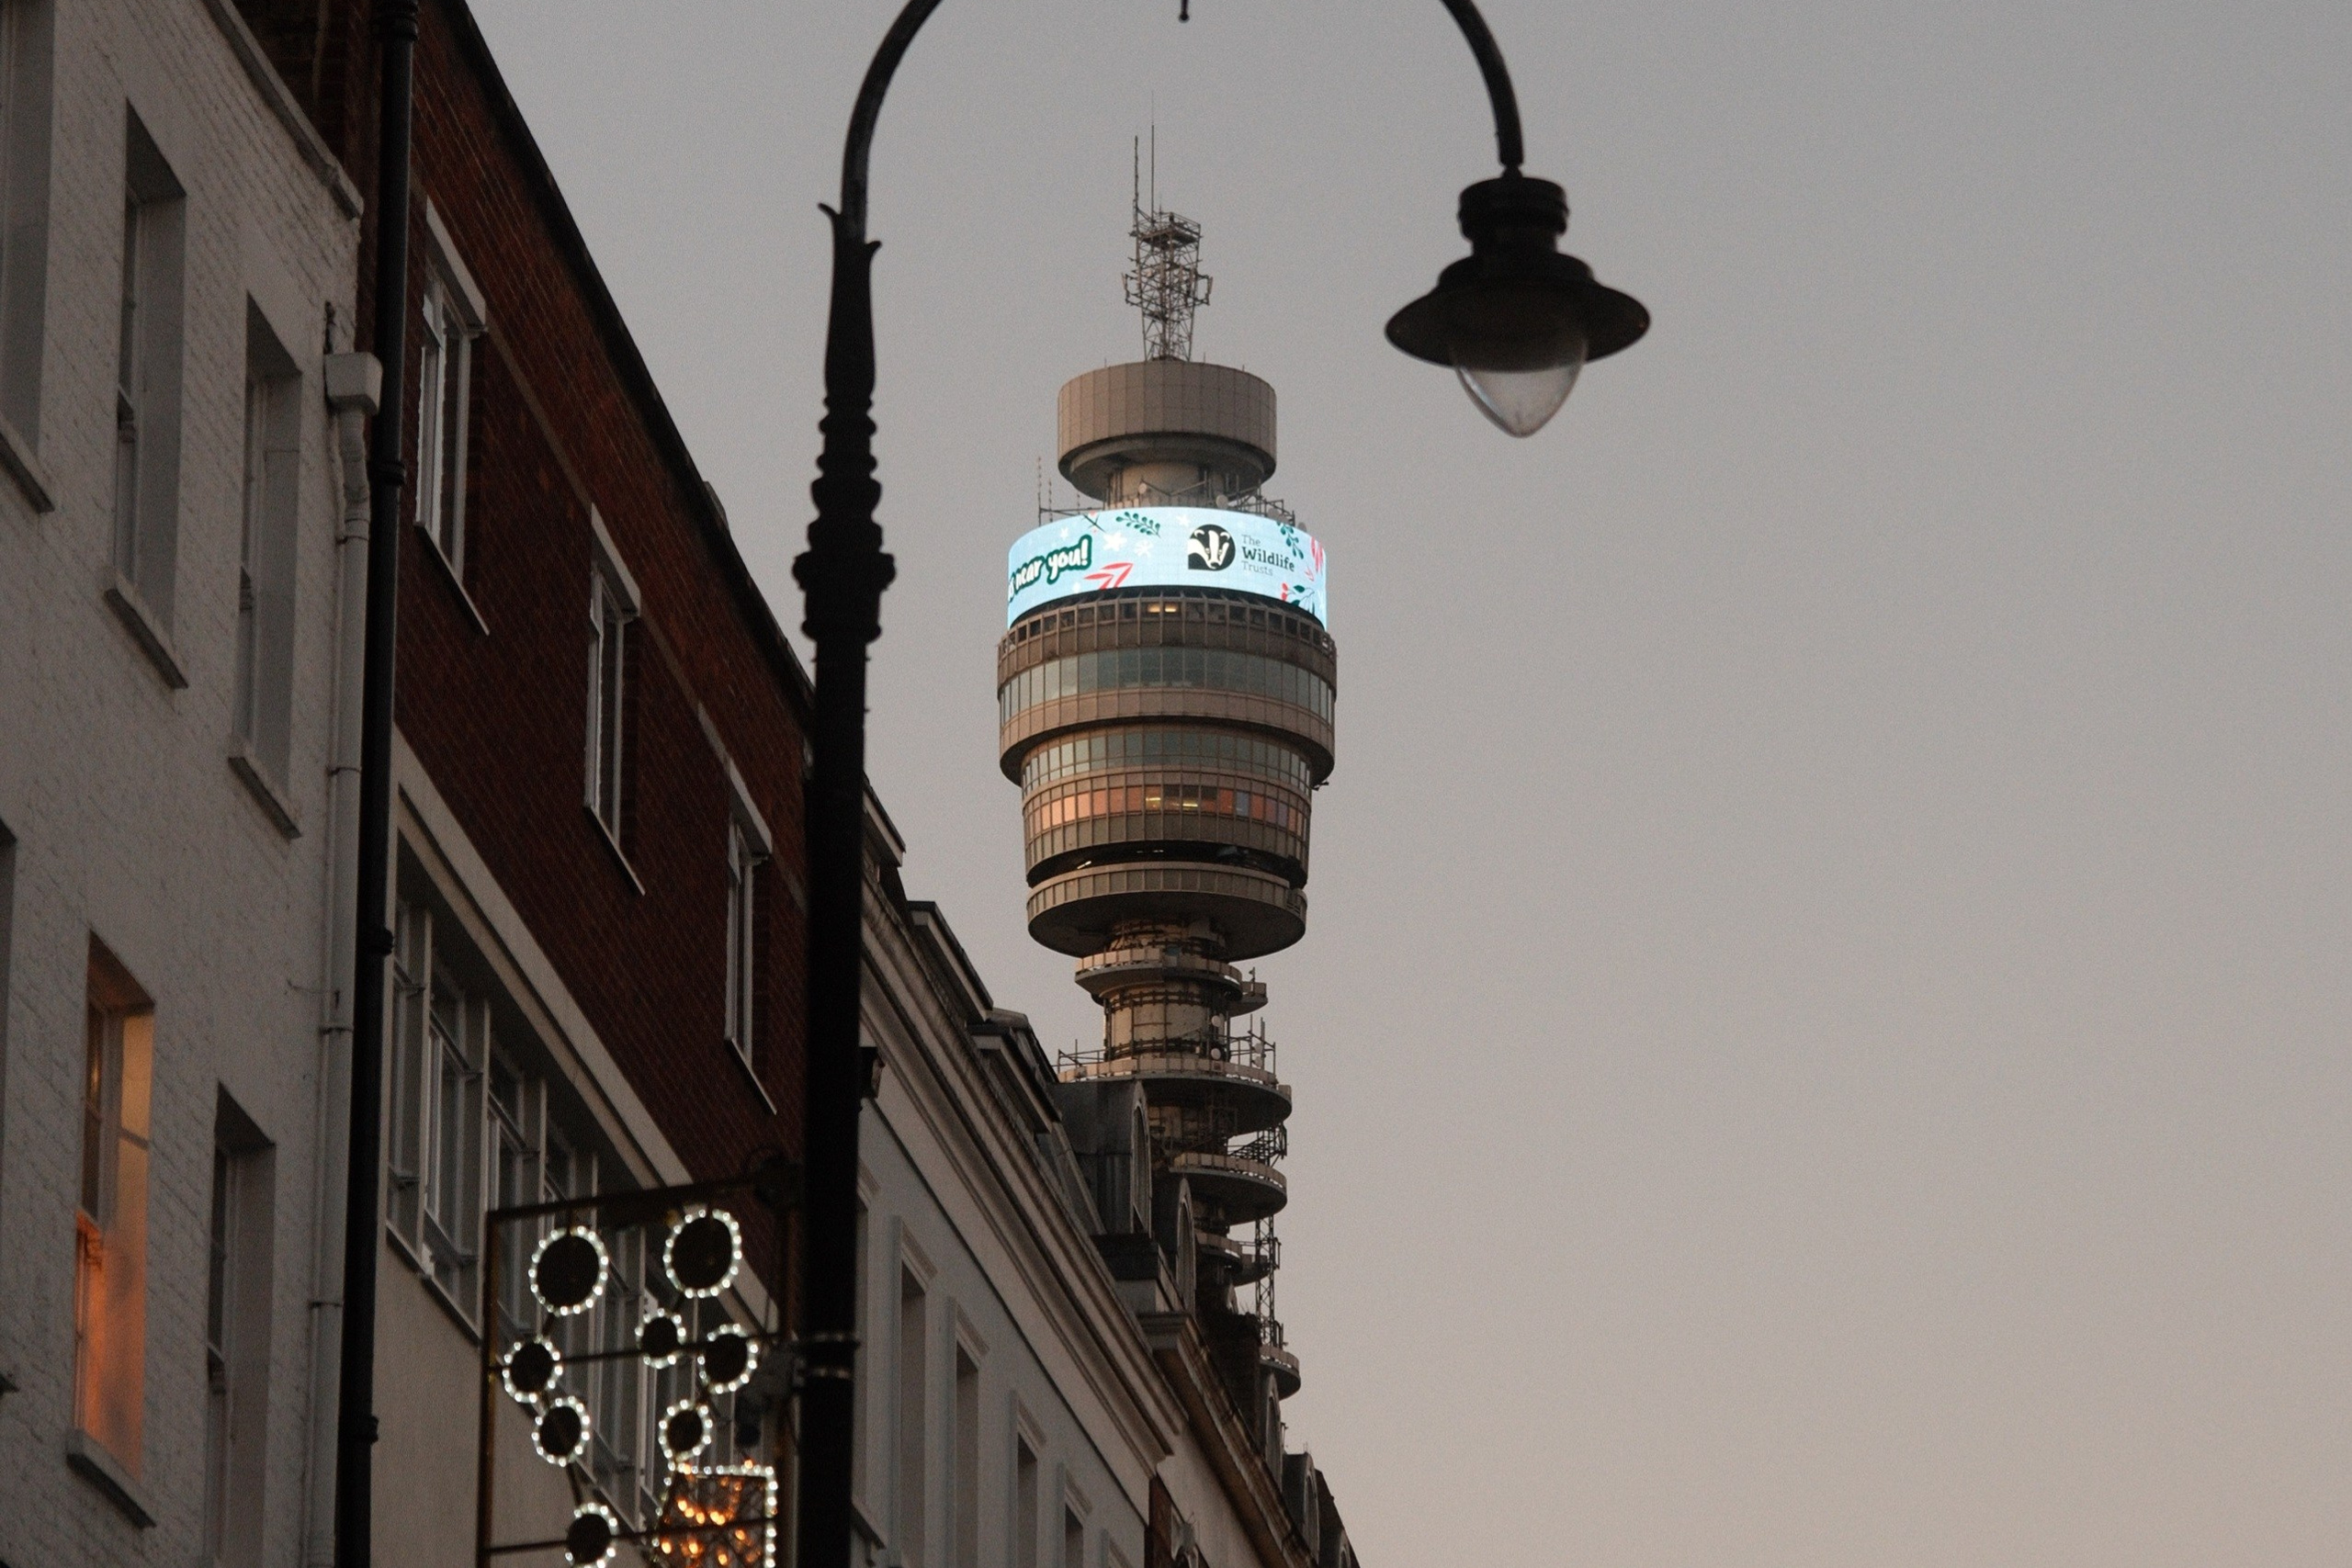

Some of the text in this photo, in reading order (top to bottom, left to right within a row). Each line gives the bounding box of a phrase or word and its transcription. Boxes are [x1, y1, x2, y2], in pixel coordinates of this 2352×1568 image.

[1241, 535, 1261, 546] The
[1014, 557, 1045, 593] near
[1046, 536, 1091, 583] you!
[1241, 547, 1295, 572] Wildlife
[1241, 560, 1273, 576] Trusts
